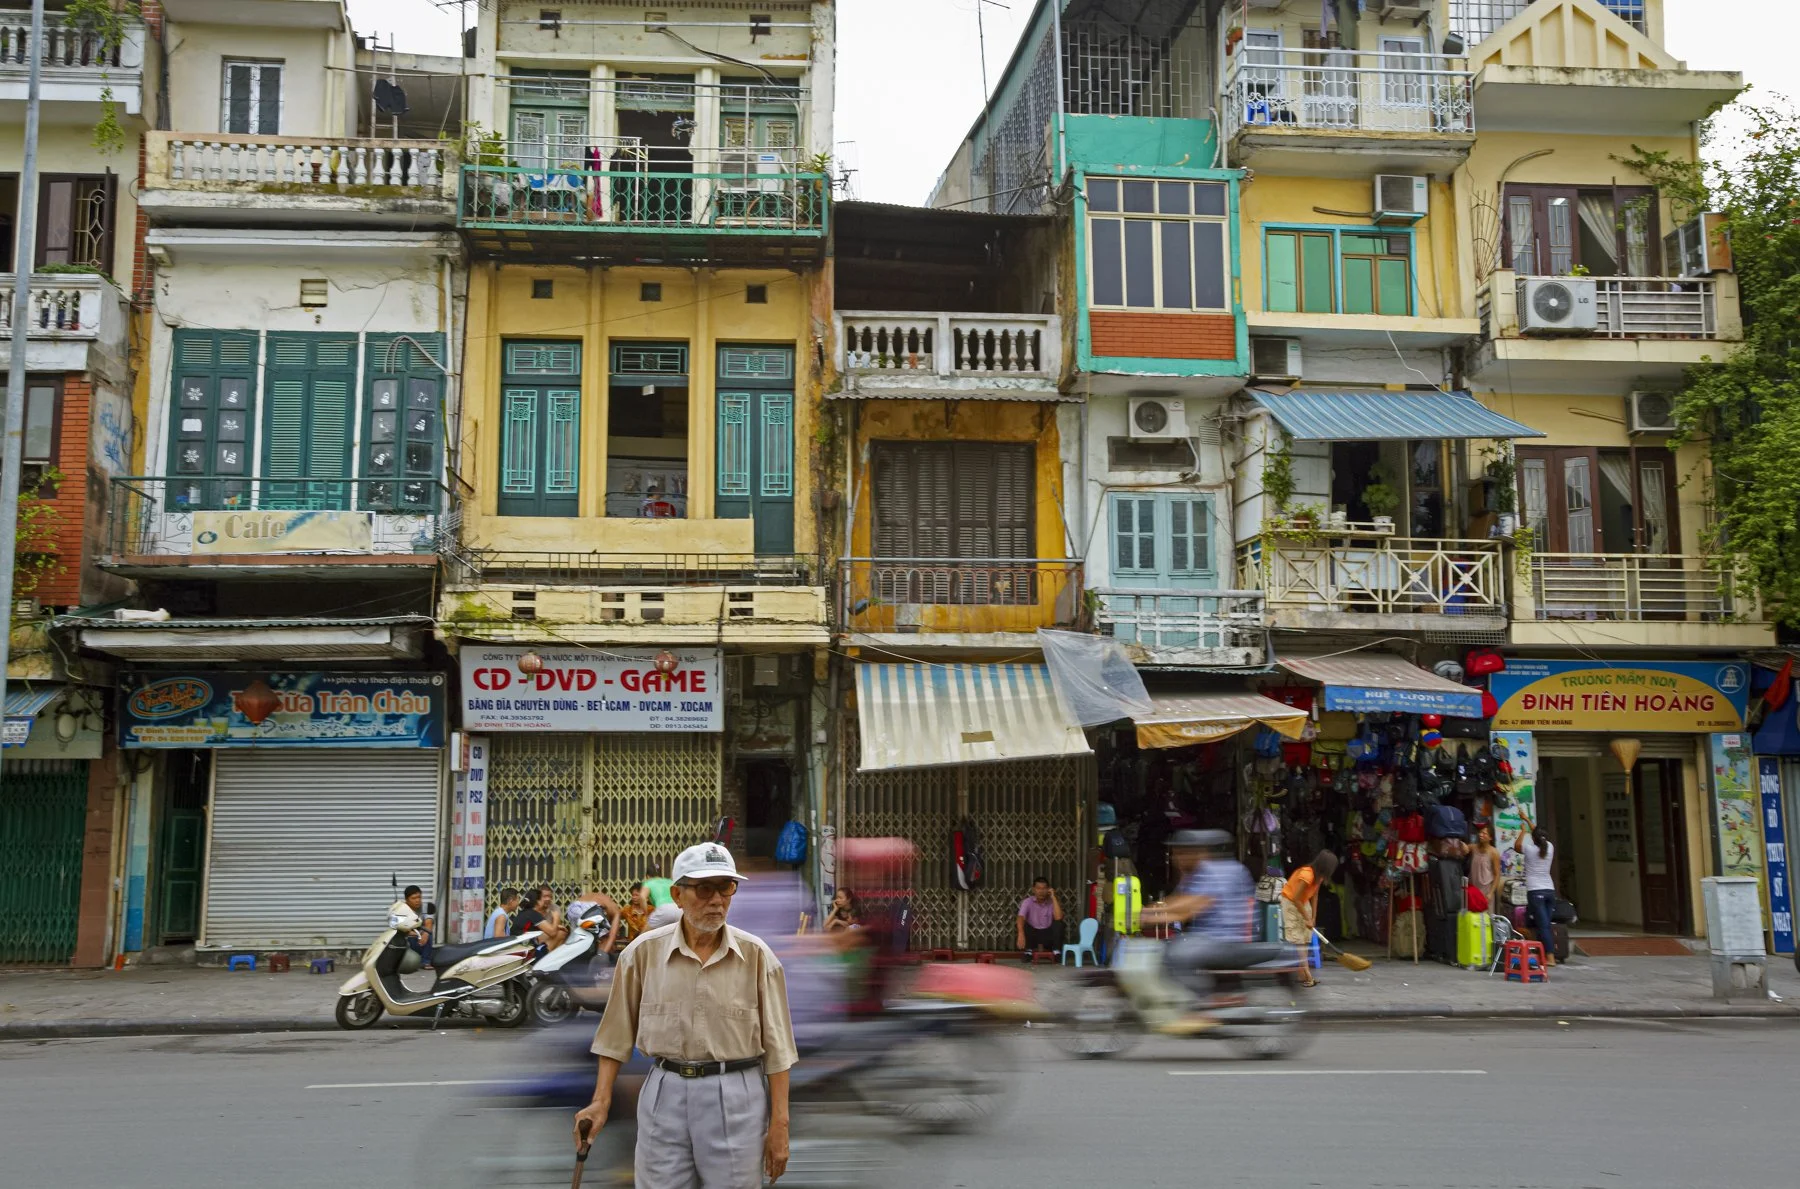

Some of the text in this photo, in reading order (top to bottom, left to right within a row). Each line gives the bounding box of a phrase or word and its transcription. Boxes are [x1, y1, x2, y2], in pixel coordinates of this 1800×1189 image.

[224, 514, 286, 540] Cafe
[505, 654, 515, 662] TY
[370, 676, 389, 685] theo
[473, 668, 511, 691] CD
[535, 668, 597, 691] DVD
[620, 669, 707, 694] GAME
[1650, 676, 1677, 688] NON
[275, 688, 428, 714] Sữa Trân Châu
[514, 697, 550, 711] CHUYÊN
[553, 697, 578, 711] DÙNG
[639, 700, 672, 712] DVCAM
[680, 701, 713, 713] XDCAM
[1522, 690, 1715, 712] ĐINH TIÊN HOÀNG
[472, 746, 482, 760] CD
[470, 768, 484, 781] DVD
[469, 790, 483, 804] PS2
